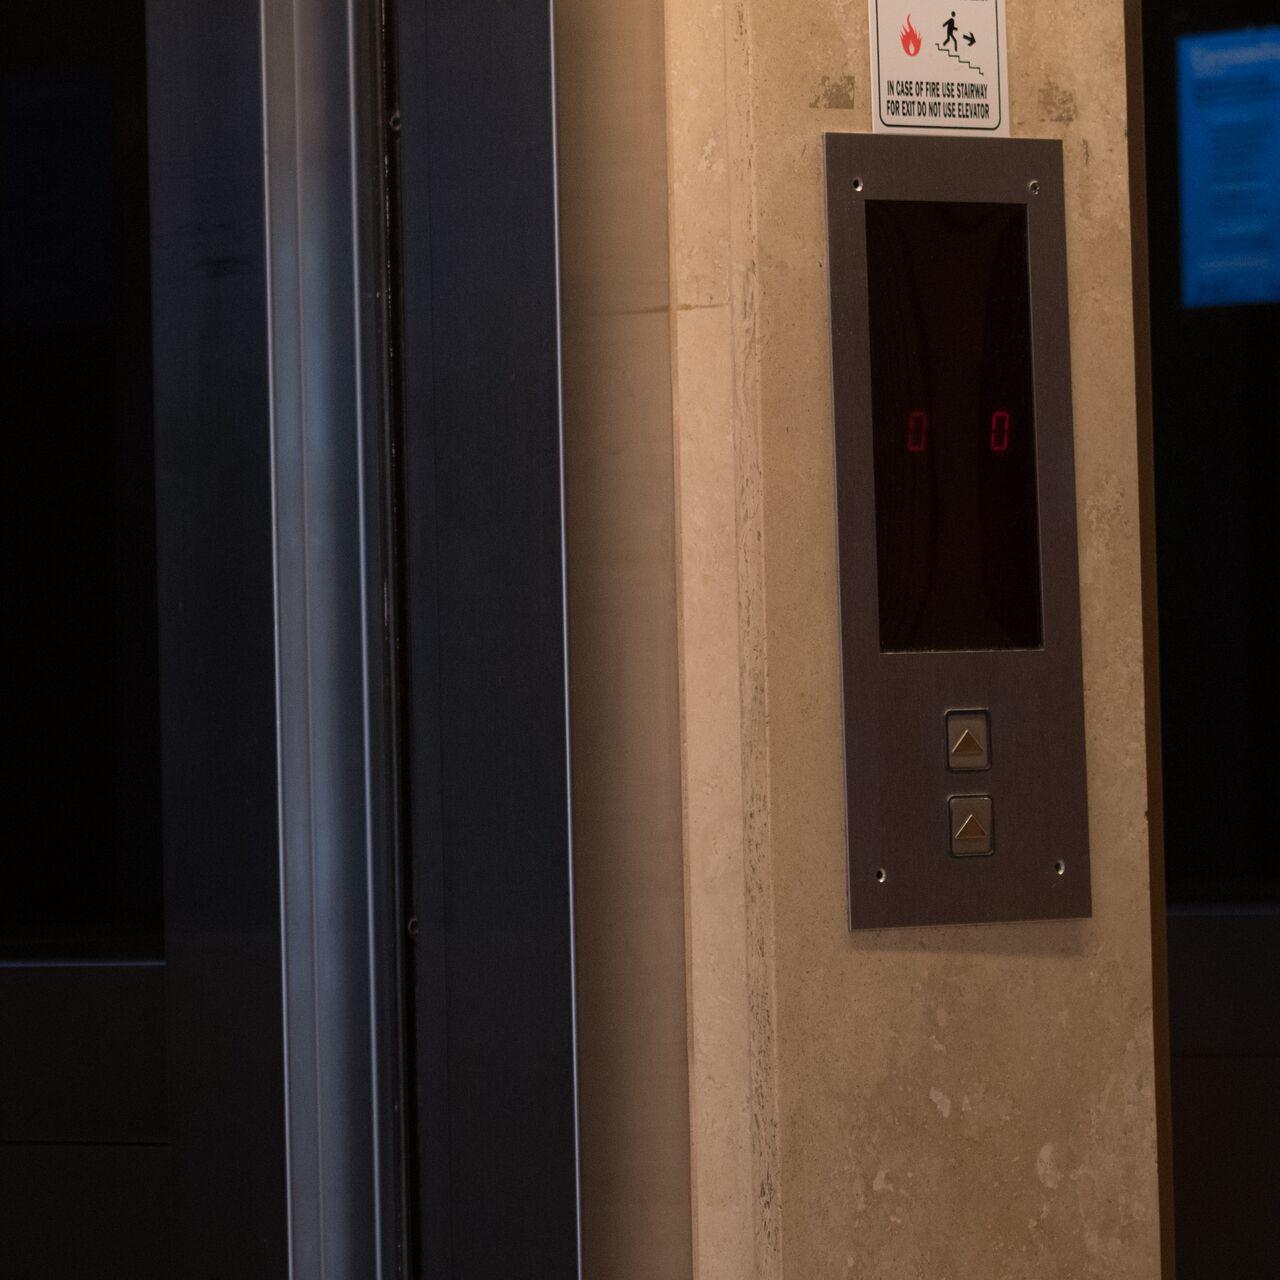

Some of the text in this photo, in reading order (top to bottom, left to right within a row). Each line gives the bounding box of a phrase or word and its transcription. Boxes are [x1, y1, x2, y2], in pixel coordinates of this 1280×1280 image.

[887, 80, 988, 99] IN CASE OF FIRE USE STAIRWAY
[887, 100, 990, 119] FOR EXIT DO NOT USE ELEVATOR
[907, 411, 928, 452] 0
[990, 411, 1010, 452] 0
